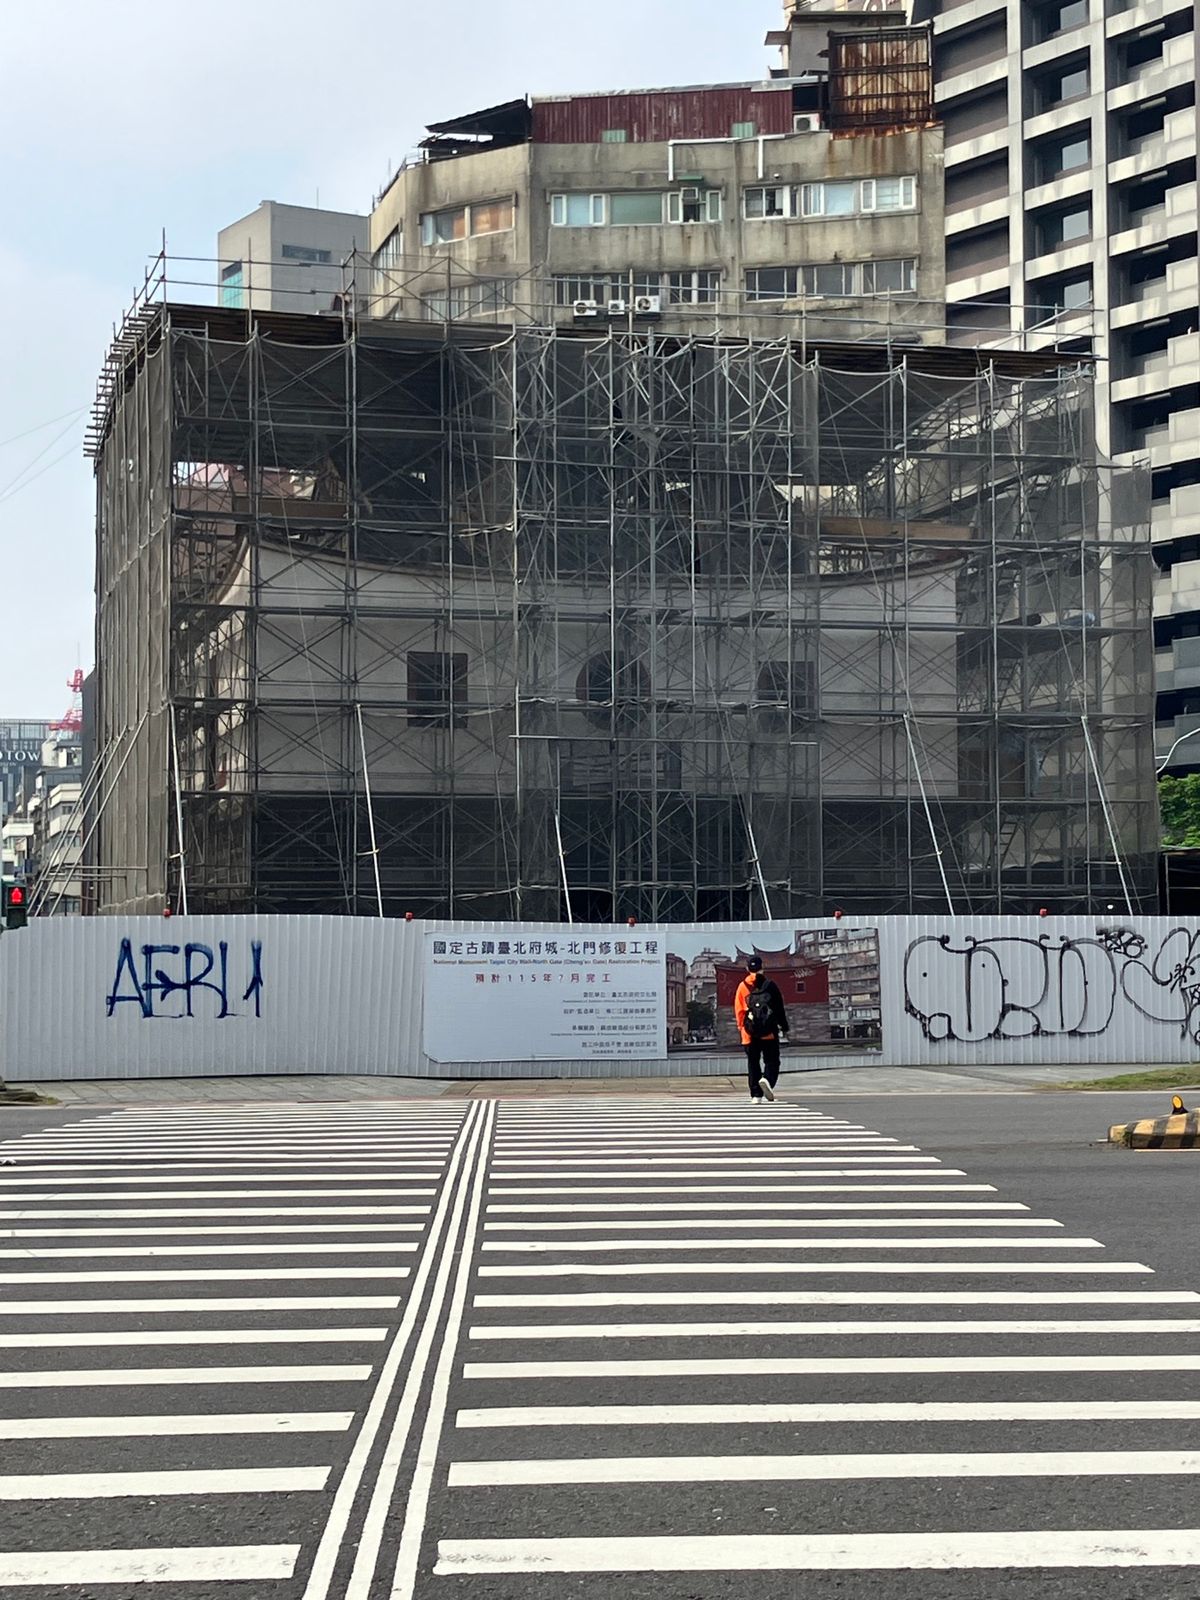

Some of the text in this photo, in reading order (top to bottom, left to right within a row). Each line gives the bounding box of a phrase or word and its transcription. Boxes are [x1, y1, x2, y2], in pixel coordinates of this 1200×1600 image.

[433, 940, 658, 955] 國定古蹟臺北府城-北門修復工程
